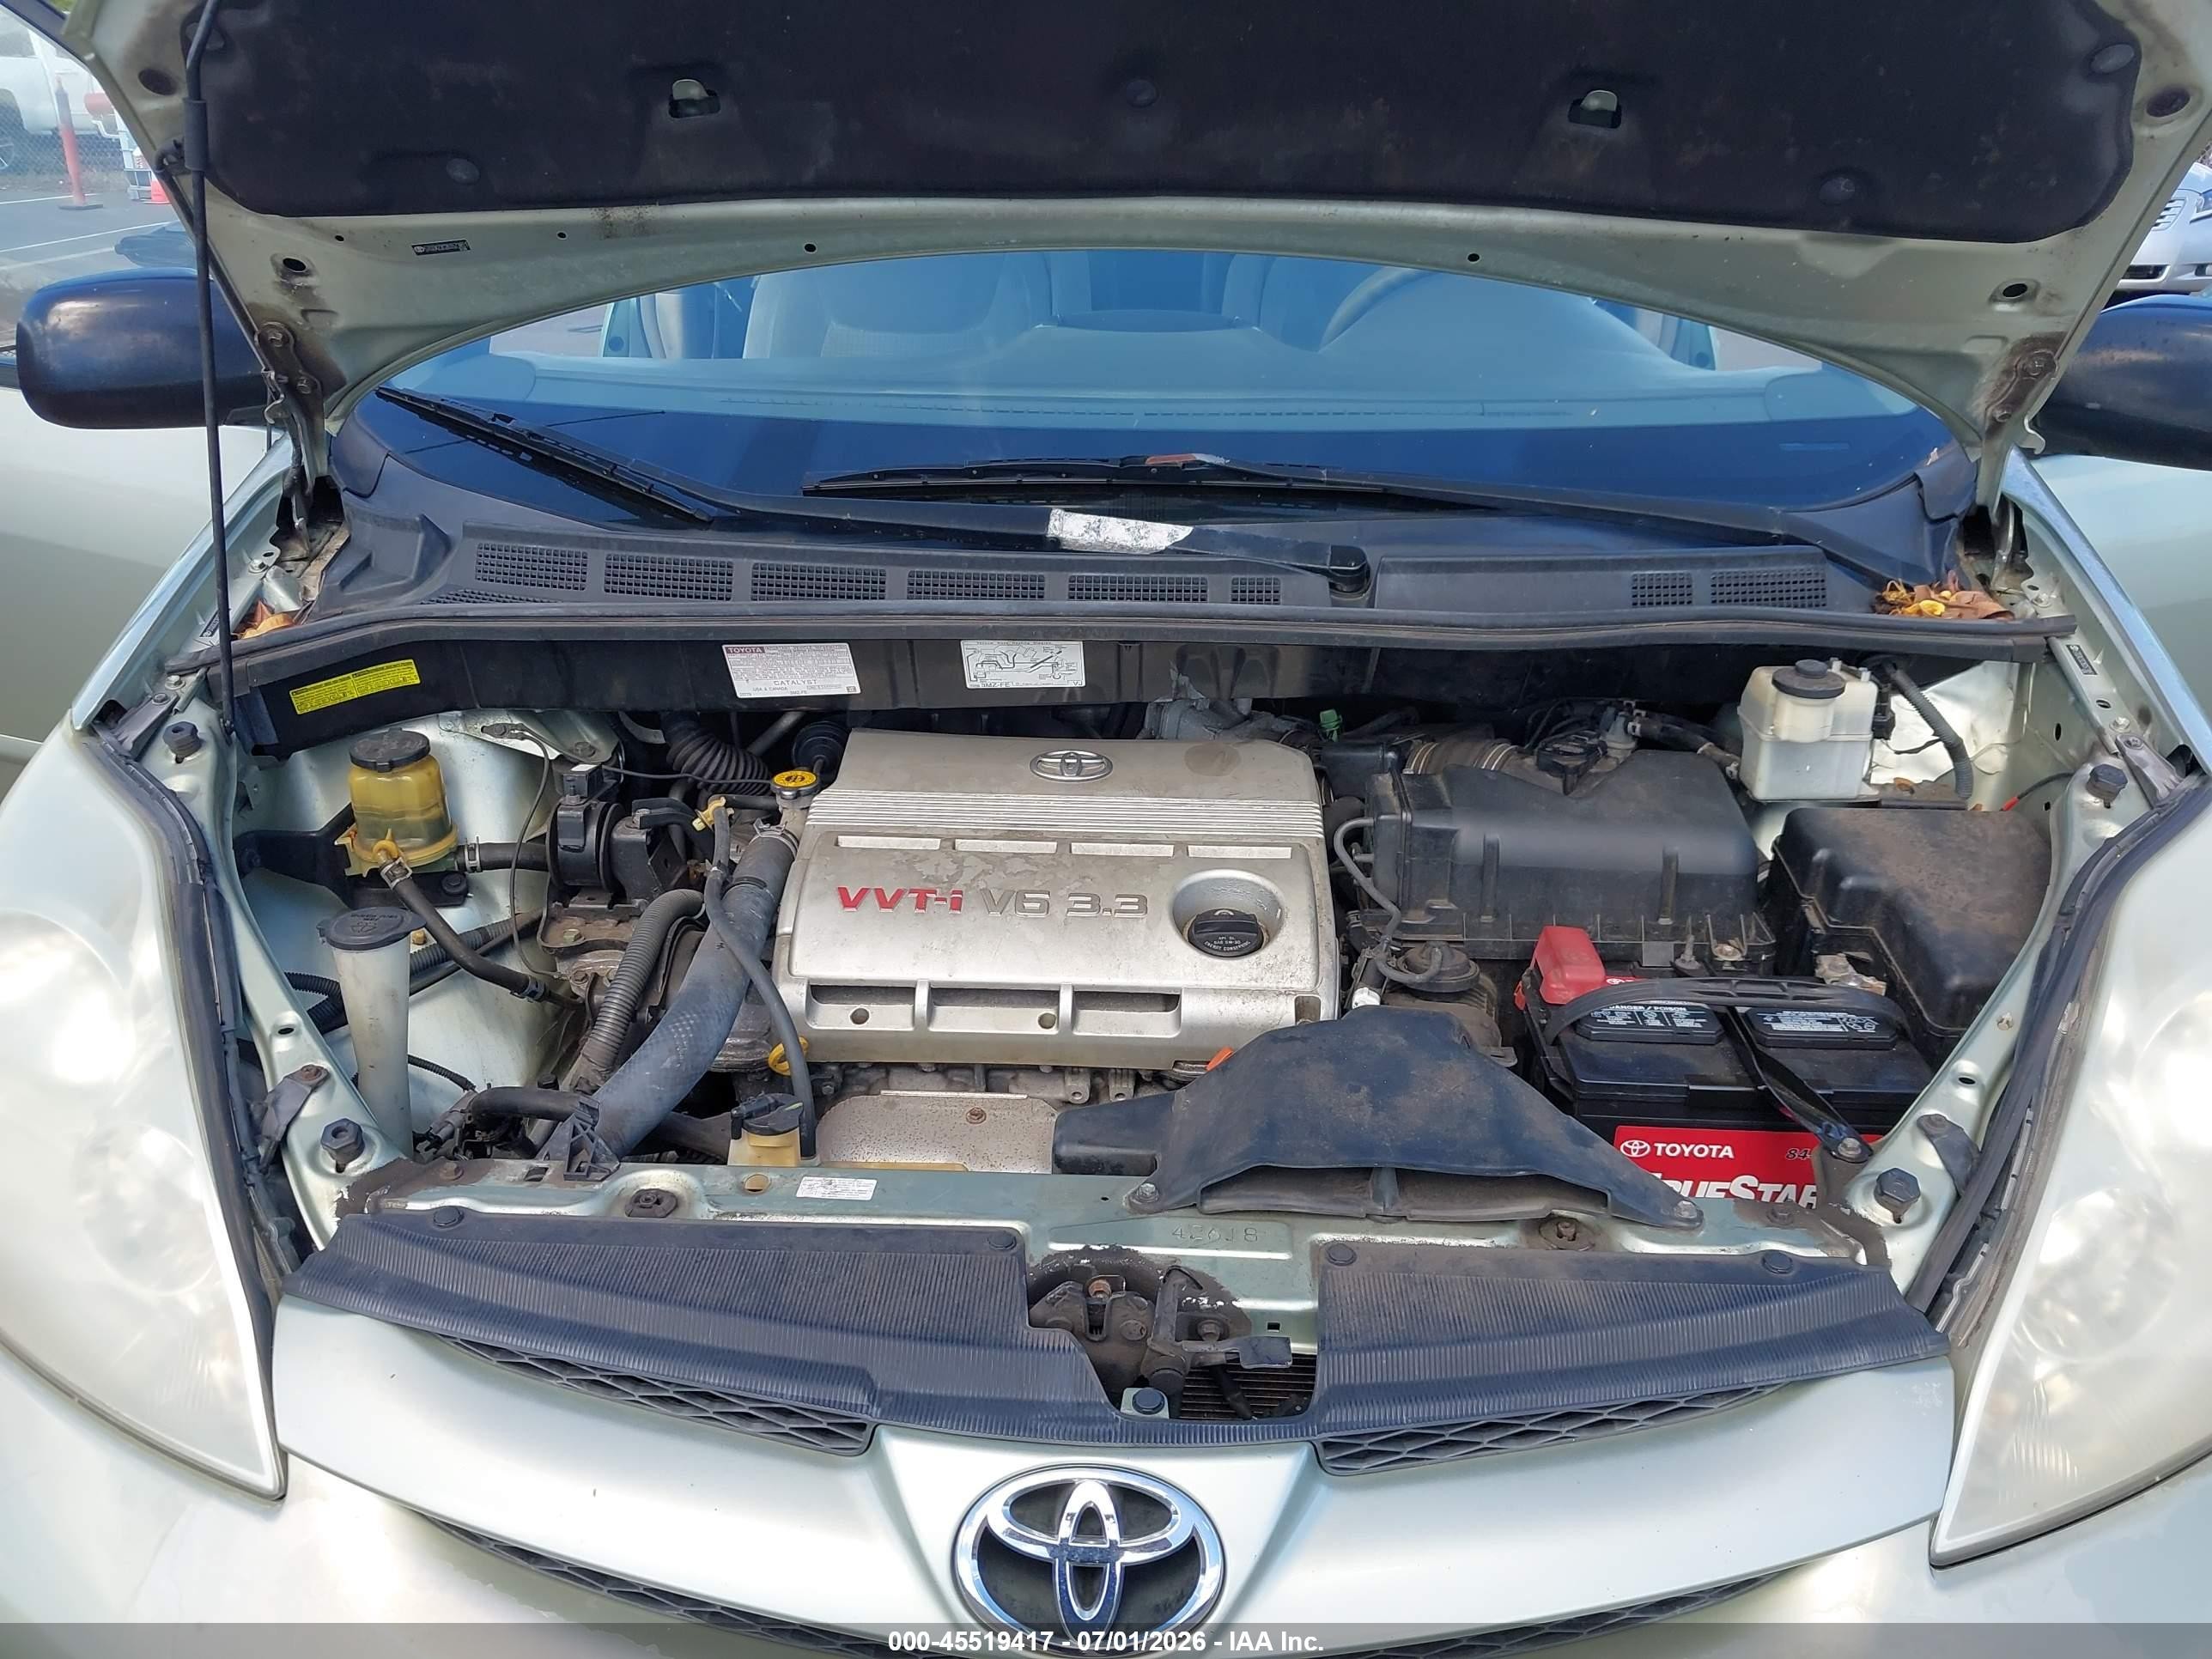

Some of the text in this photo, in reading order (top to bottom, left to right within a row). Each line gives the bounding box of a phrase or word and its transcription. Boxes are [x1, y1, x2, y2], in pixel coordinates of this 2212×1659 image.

[837, 886, 1149, 918] VVT-i V6 3.3
[1654, 1143, 1735, 1159] TOYOTA
